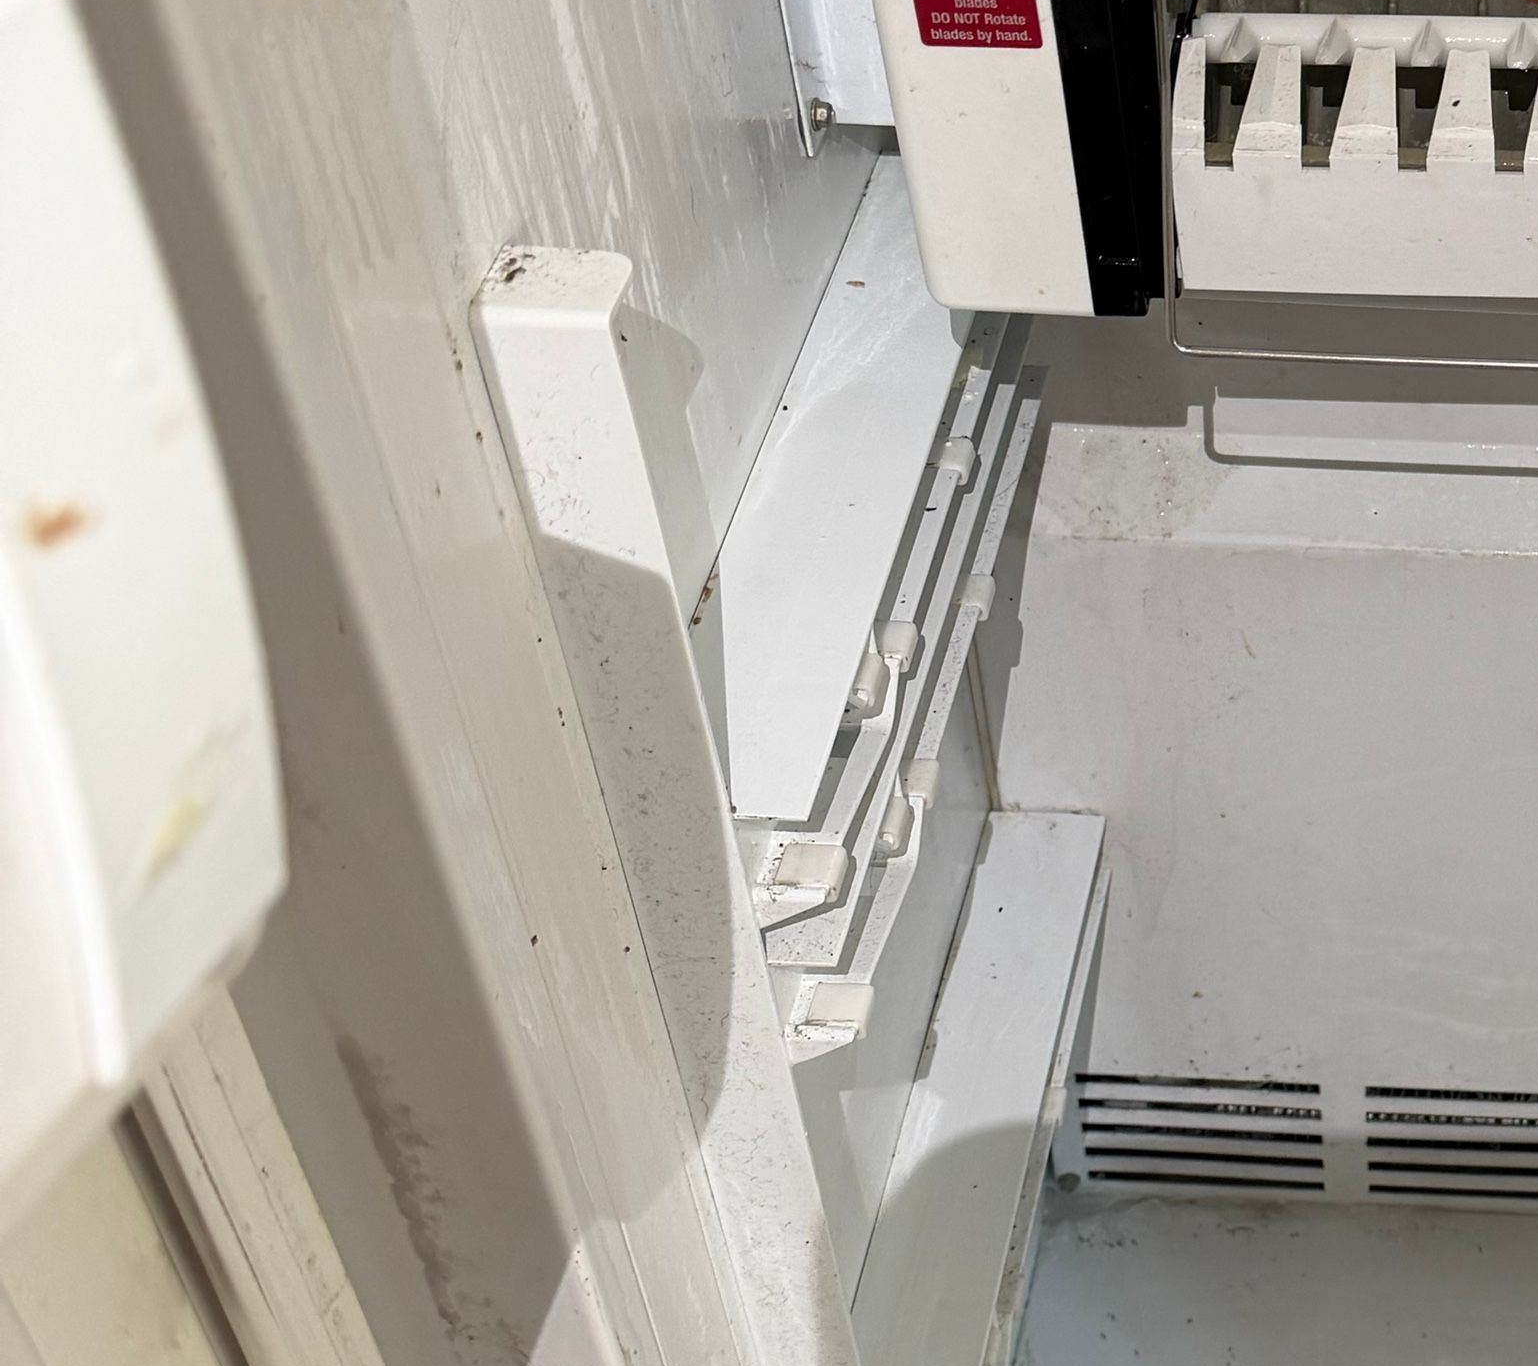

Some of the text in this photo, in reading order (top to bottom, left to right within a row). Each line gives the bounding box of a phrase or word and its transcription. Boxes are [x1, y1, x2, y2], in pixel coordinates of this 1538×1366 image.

[931, 12, 1025, 25] DO NOT Rotate
[931, 29, 1032, 43] blades by hand.
